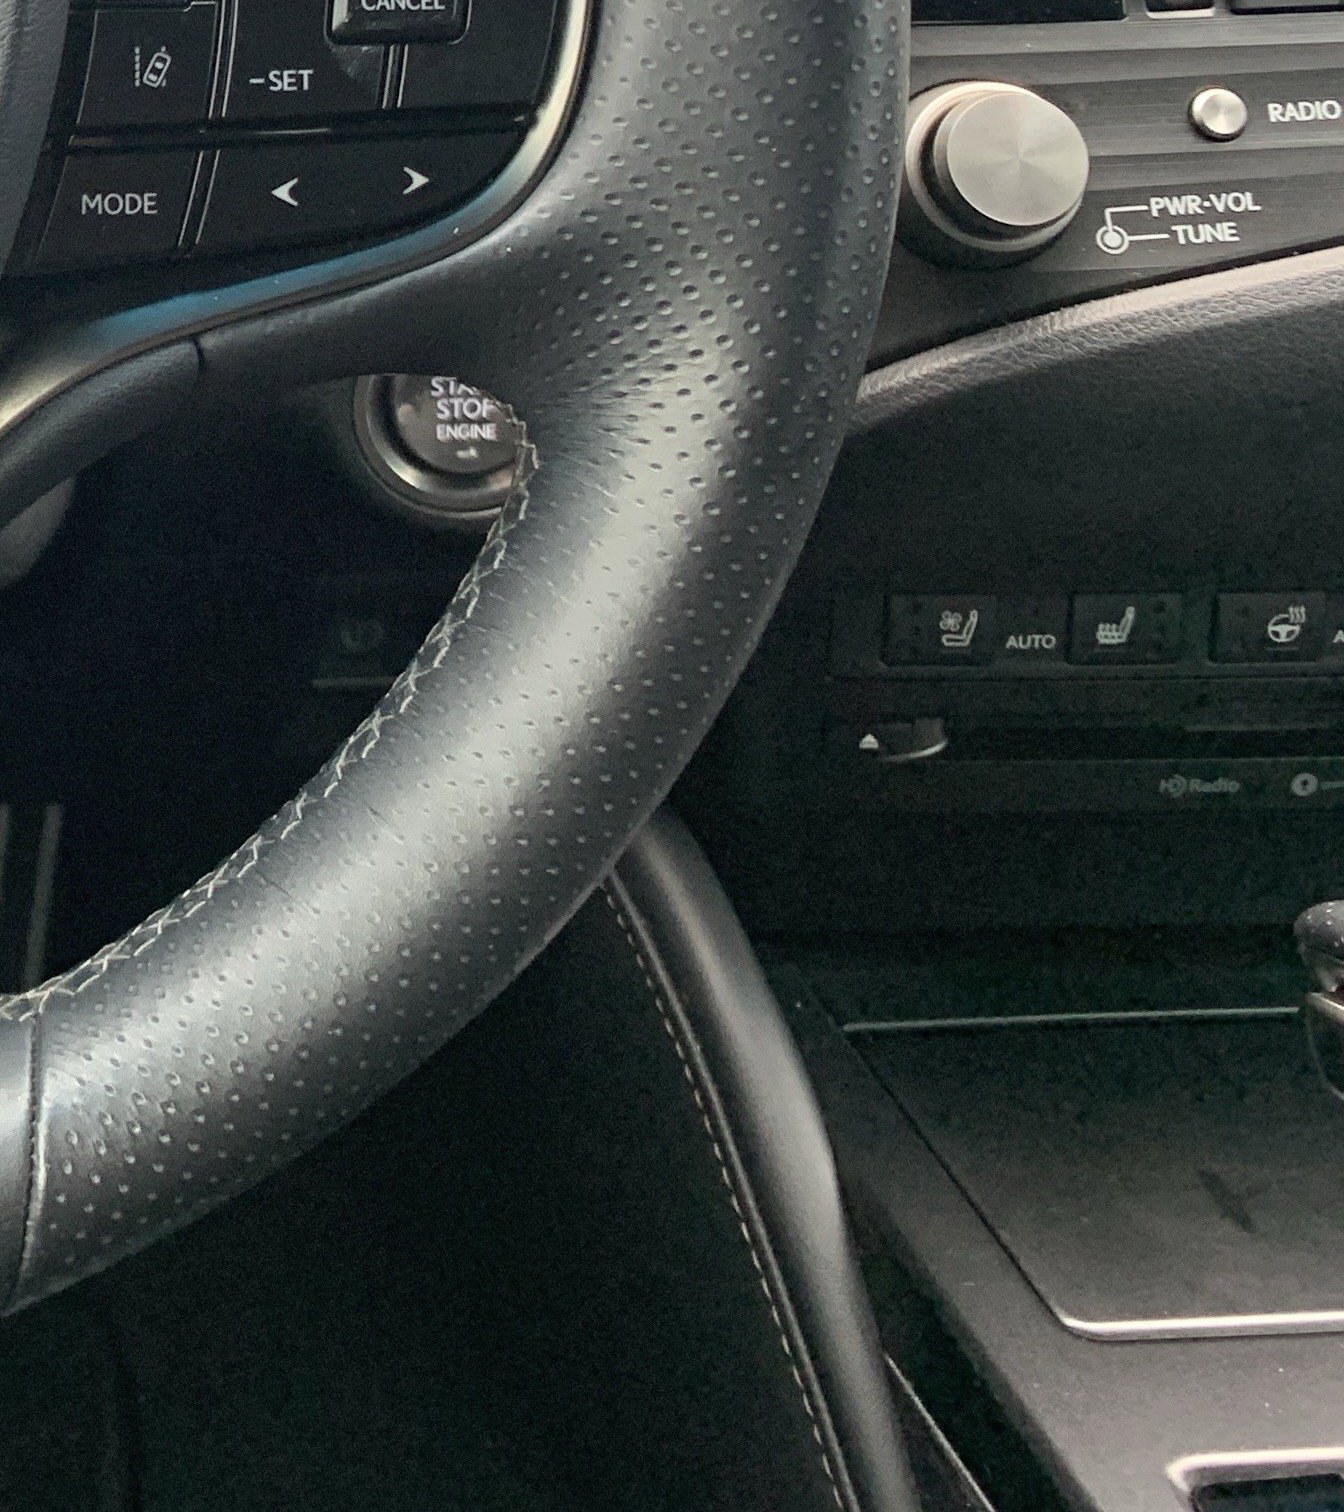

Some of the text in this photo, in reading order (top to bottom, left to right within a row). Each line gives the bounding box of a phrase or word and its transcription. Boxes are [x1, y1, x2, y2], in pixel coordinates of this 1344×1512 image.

[1268, 100, 1342, 123] RADIO
[82, 193, 157, 215] MODE
[1171, 222, 1240, 244] TUNE
[436, 423, 497, 442] ENGINE
[1006, 634, 1056, 649] AUTO
